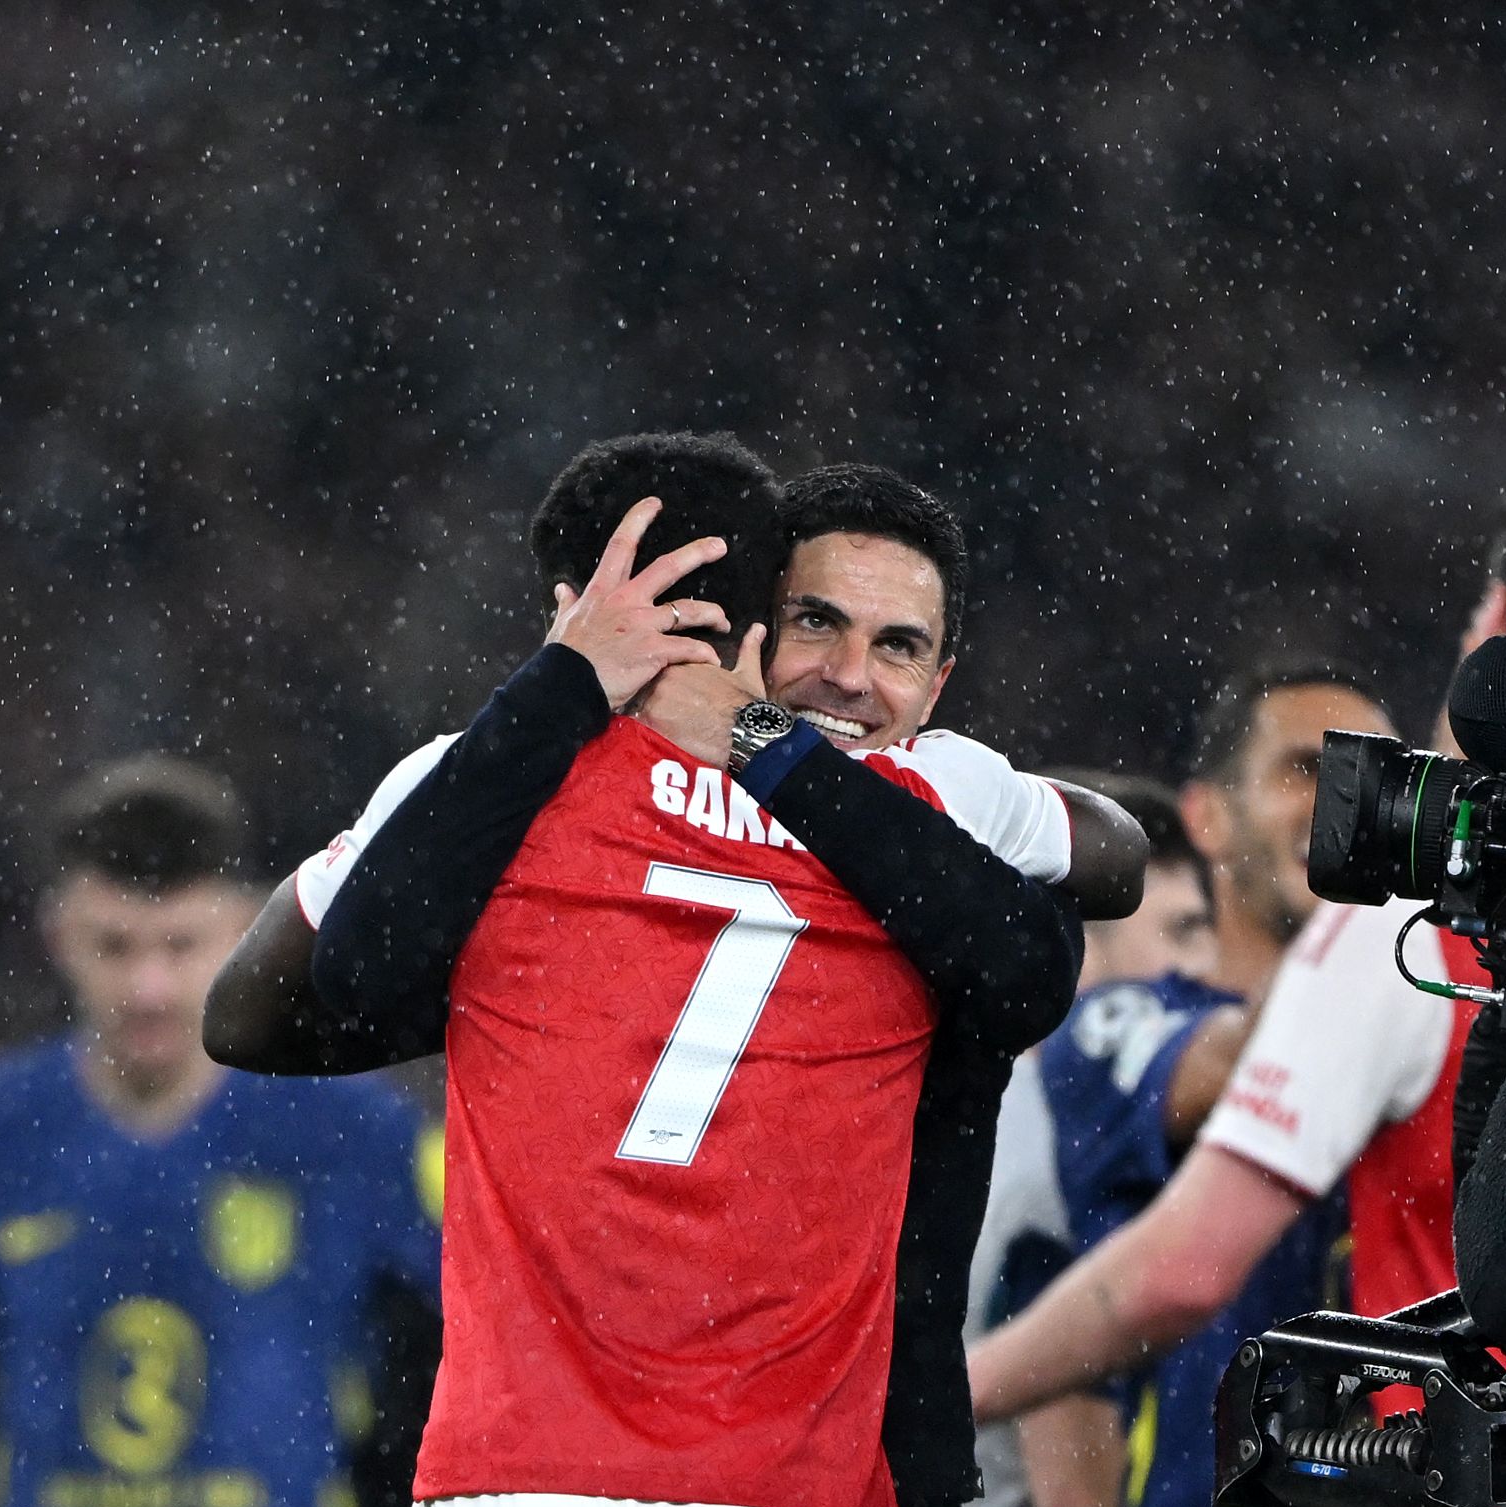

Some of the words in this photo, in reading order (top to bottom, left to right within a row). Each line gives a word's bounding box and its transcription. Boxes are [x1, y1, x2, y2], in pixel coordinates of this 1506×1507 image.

[614, 860, 810, 1167] 7
[1361, 1363, 1411, 1381] STEADICAM
[1311, 1462, 1331, 1476] G-70
